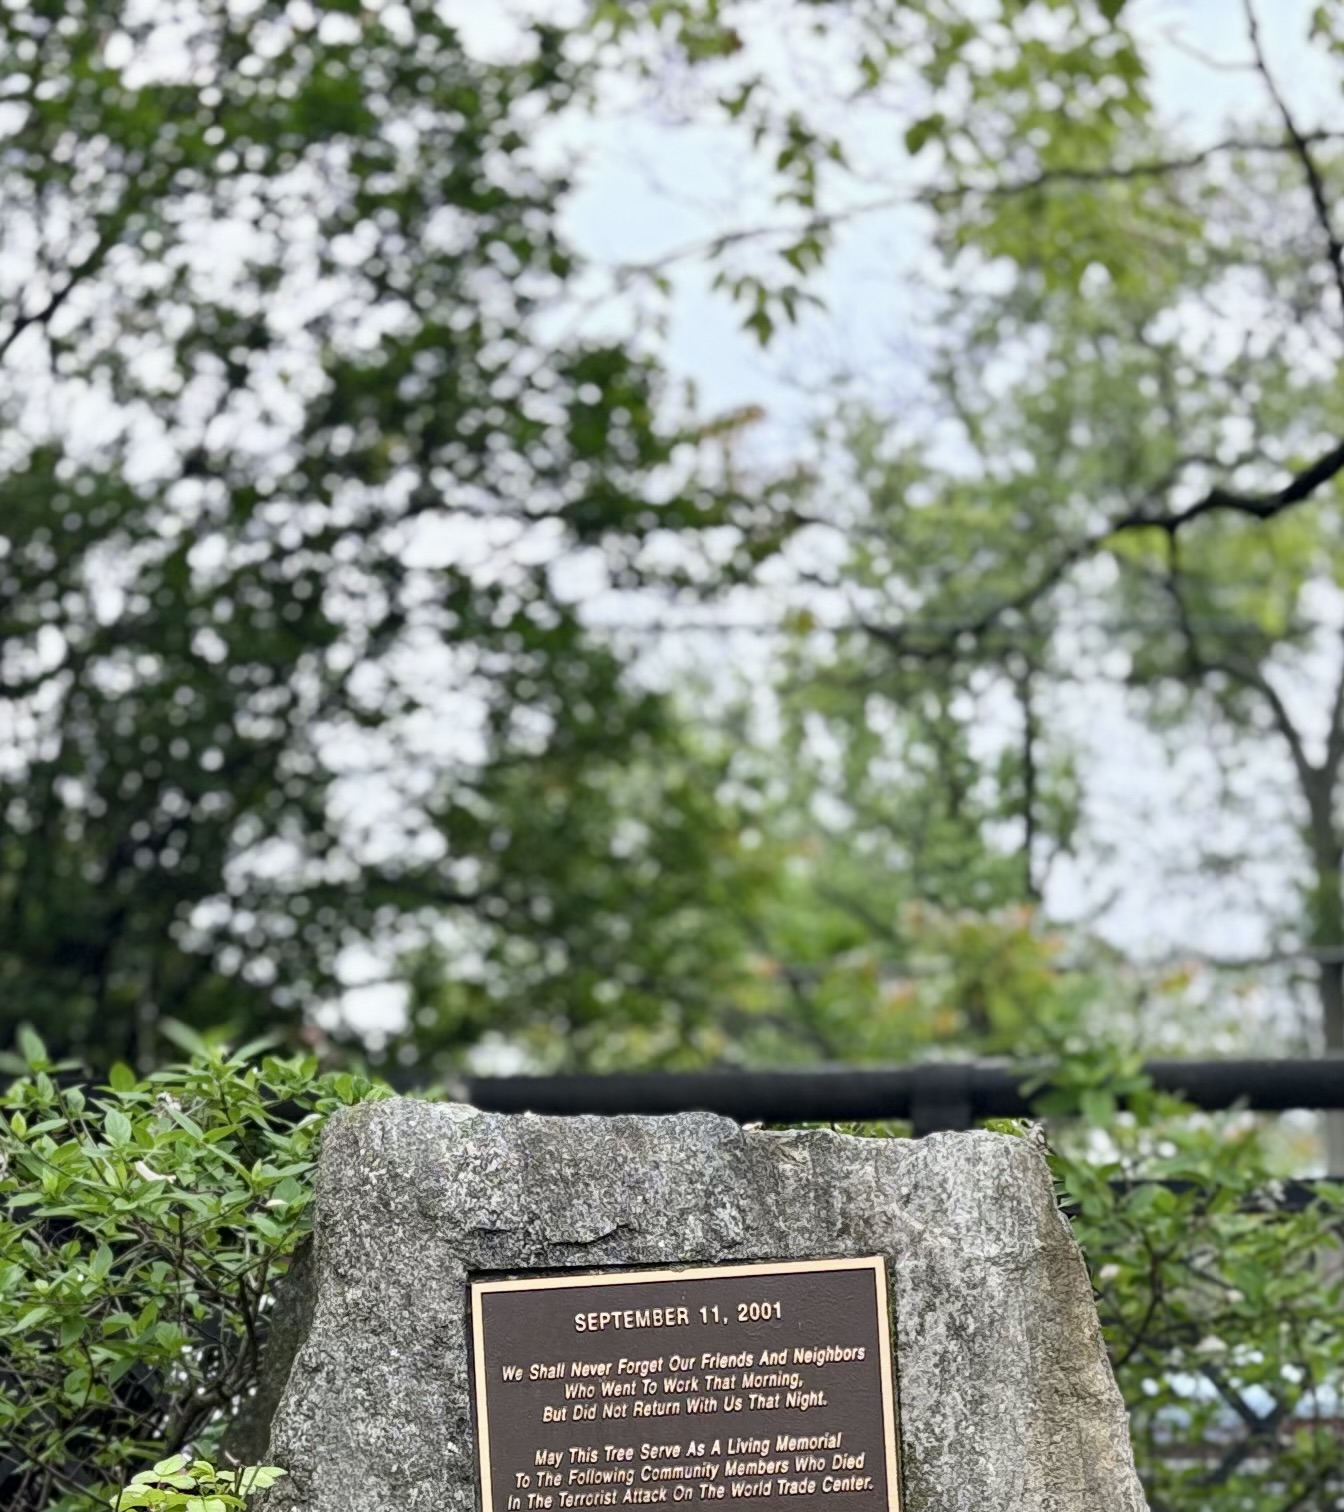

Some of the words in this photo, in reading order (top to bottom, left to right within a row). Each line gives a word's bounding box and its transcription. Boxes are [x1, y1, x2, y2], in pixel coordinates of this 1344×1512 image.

[574, 1306, 690, 1332] SEPTEMBER
[699, 1304, 729, 1325] 11,
[737, 1300, 782, 1322] 2001
[502, 1364, 524, 1382] We
[528, 1361, 566, 1381] Shall
[570, 1360, 614, 1378] Never
[617, 1356, 665, 1378] Forget
[668, 1354, 697, 1372] Our
[700, 1350, 755, 1370] Friends
[758, 1347, 789, 1366] And
[792, 1344, 866, 1367] Neighbors
[564, 1382, 596, 1400] Who
[600, 1379, 637, 1397] Went
[641, 1377, 658, 1395] To
[663, 1375, 699, 1393] Work
[704, 1373, 737, 1391] That
[741, 1369, 804, 1390] Morning,
[542, 1405, 568, 1423] But
[572, 1402, 598, 1421] Did
[602, 1402, 628, 1419] Not
[632, 1399, 681, 1417] Return
[686, 1396, 718, 1414] With
[723, 1394, 743, 1412] Us
[748, 1392, 781, 1410] That
[785, 1389, 828, 1411] Night.
[534, 1448, 564, 1469] May
[568, 1446, 599, 1464] This
[603, 1444, 635, 1462] Tree
[639, 1442, 682, 1460] Serve
[685, 1439, 706, 1457] As
[710, 1438, 722, 1456] A
[727, 1436, 771, 1457] Living
[775, 1431, 843, 1452] Memorial
[514, 1471, 531, 1489] To
[535, 1470, 563, 1488] The
[567, 1466, 636, 1486] Following
[640, 1461, 721, 1482] Community
[724, 1457, 790, 1477] Members
[794, 1454, 827, 1472] Who
[831, 1451, 866, 1470] Died
[507, 1494, 521, 1511] In
[526, 1492, 553, 1510] The
[558, 1488, 618, 1508] Terrorist
[621, 1486, 668, 1504] Attack
[672, 1483, 694, 1502] On
[698, 1482, 726, 1499] The
[731, 1478, 773, 1498] World
[776, 1476, 817, 1495] Trade
[821, 1474, 875, 1493] Center.
